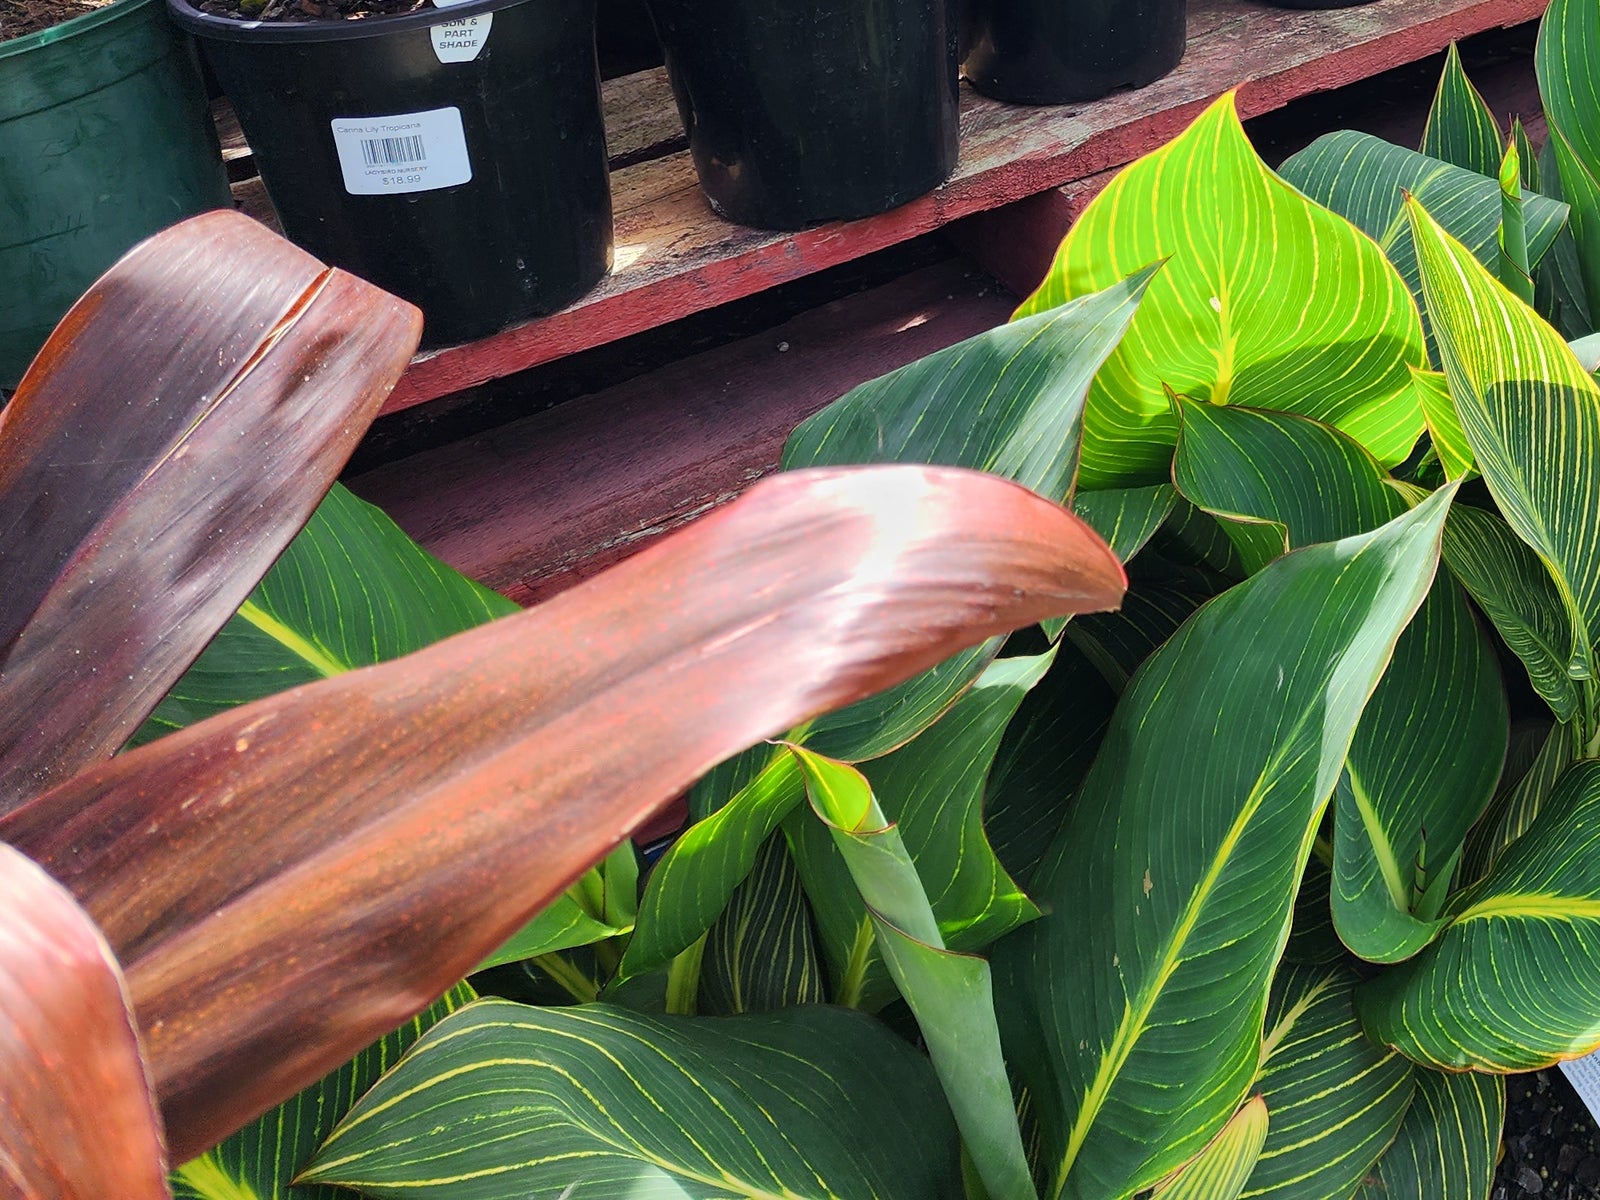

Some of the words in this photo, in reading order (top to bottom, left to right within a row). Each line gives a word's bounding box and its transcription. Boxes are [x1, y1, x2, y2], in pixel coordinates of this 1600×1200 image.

[441, 18, 466, 28] SUN
[470, 17, 478, 26] &
[444, 29, 474, 39] PART
[439, 39, 479, 50] SHADE
[336, 126, 364, 134] Canna
[365, 125, 379, 133] Lily
[381, 121, 421, 132] Tropicana
[382, 174, 421, 186] $18.99
